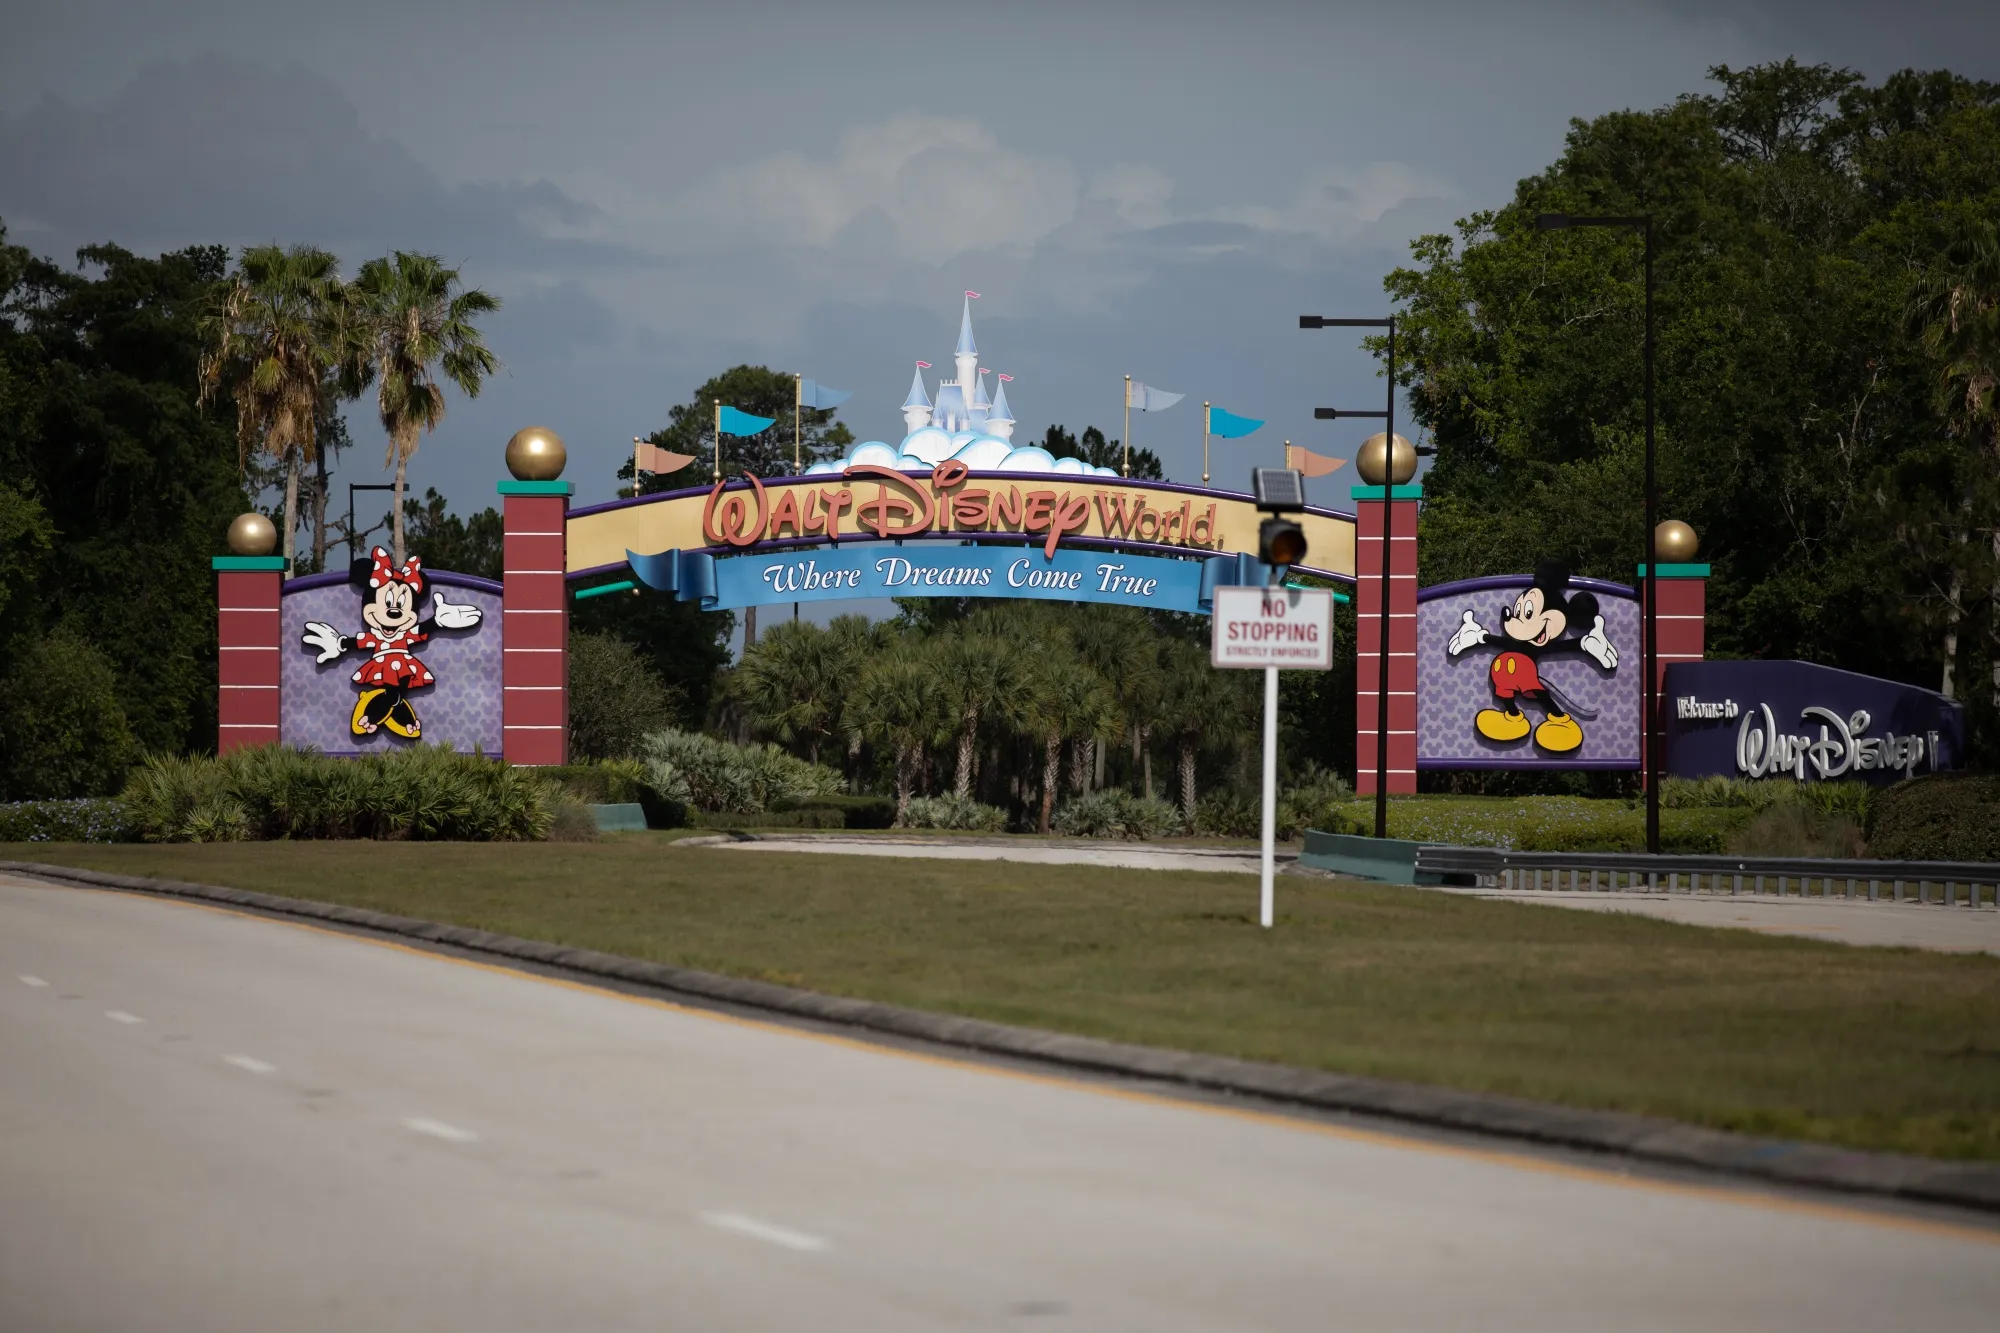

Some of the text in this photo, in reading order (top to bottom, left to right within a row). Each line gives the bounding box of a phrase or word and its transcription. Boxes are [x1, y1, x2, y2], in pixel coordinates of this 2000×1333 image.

[1094, 490, 1216, 543] World
[763, 557, 1157, 596] Where Dreams Come True
[1261, 600, 1286, 618] NO
[1228, 622, 1318, 642] STOPPING
[1677, 696, 1738, 718] Welcome to
